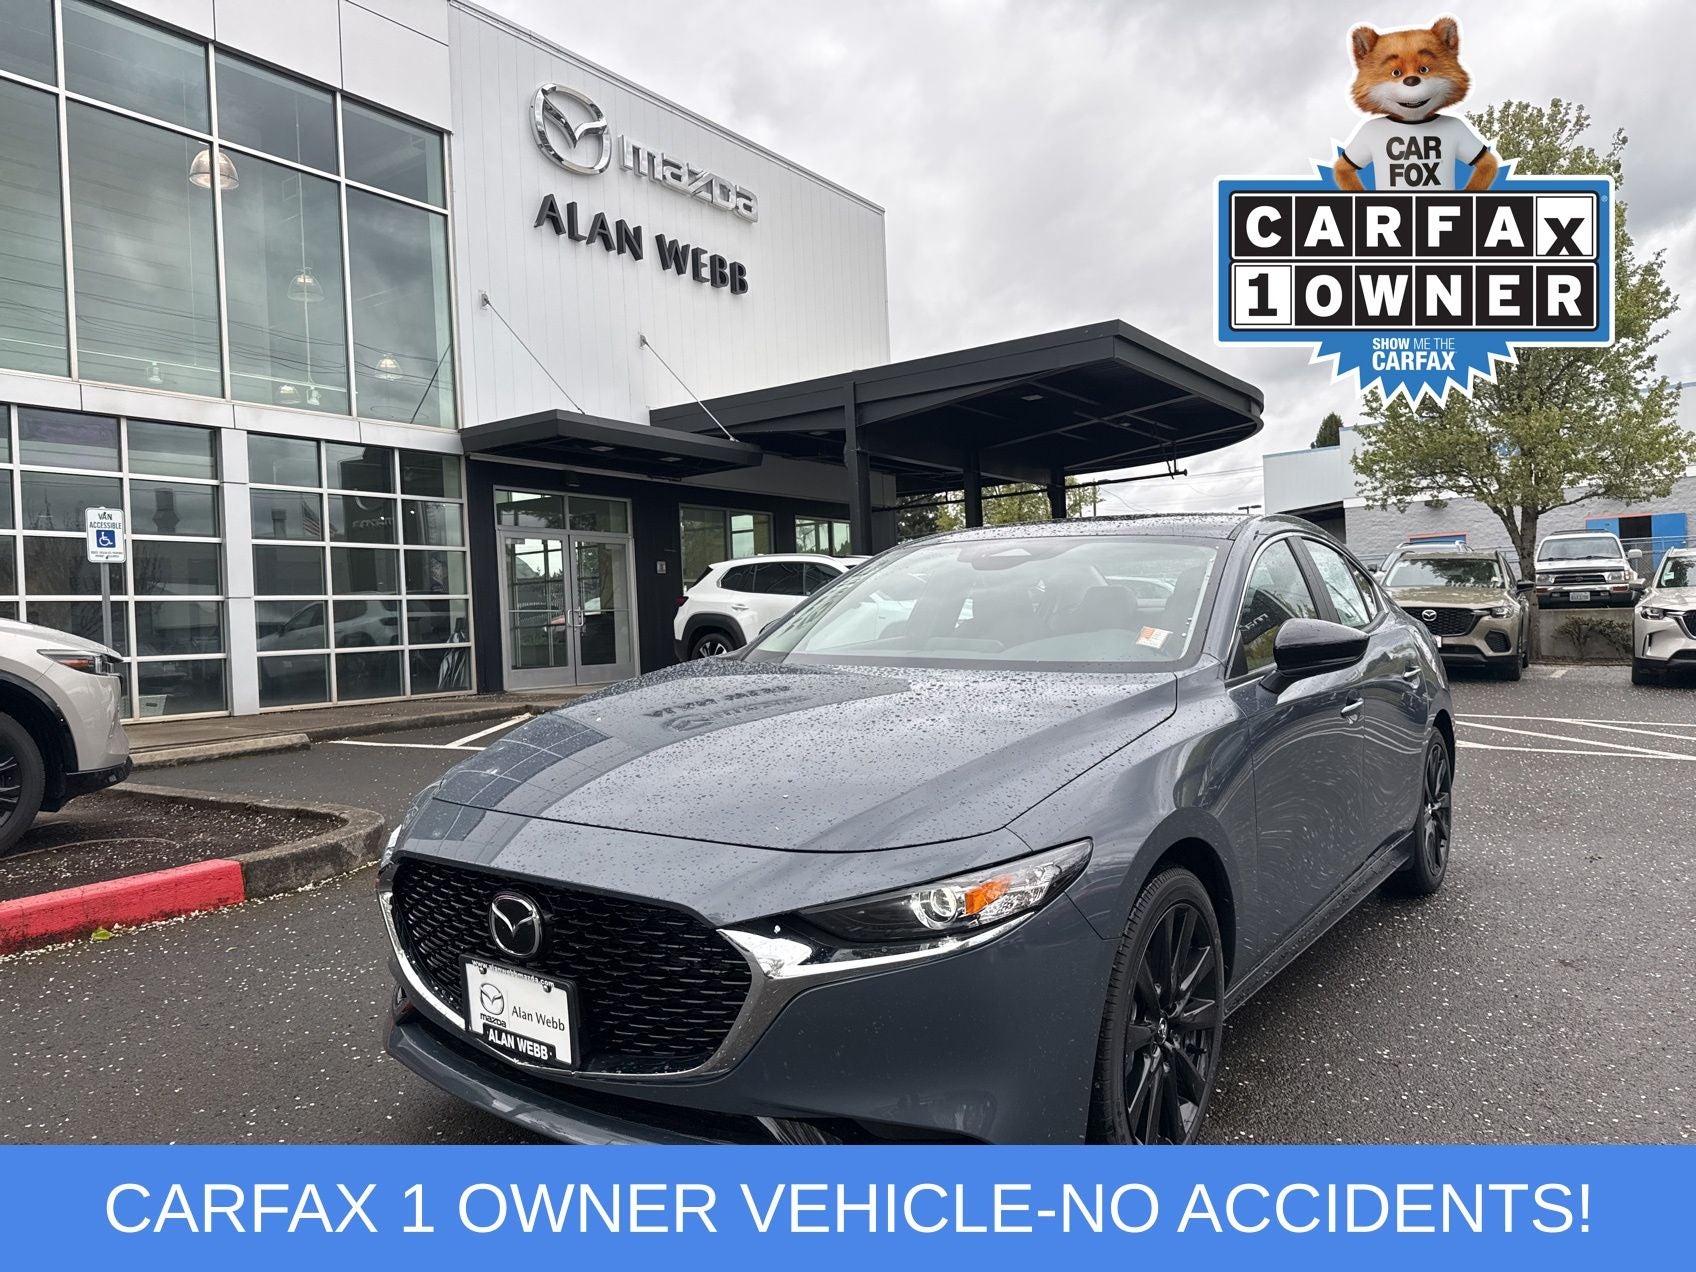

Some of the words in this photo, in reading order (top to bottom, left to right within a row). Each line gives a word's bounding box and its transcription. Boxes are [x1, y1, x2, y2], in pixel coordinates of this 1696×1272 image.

[618, 134, 759, 223] mazda
[534, 193, 644, 261] ALAN
[655, 233, 748, 295] WEBB
[90, 521, 121, 529] ACCESSIBLE
[480, 1012, 507, 1029] mazda
[511, 1005, 534, 1022] Alan
[535, 1011, 565, 1032] Webb
[488, 1028, 515, 1050] ALAN
[516, 1036, 549, 1061] WEBB
